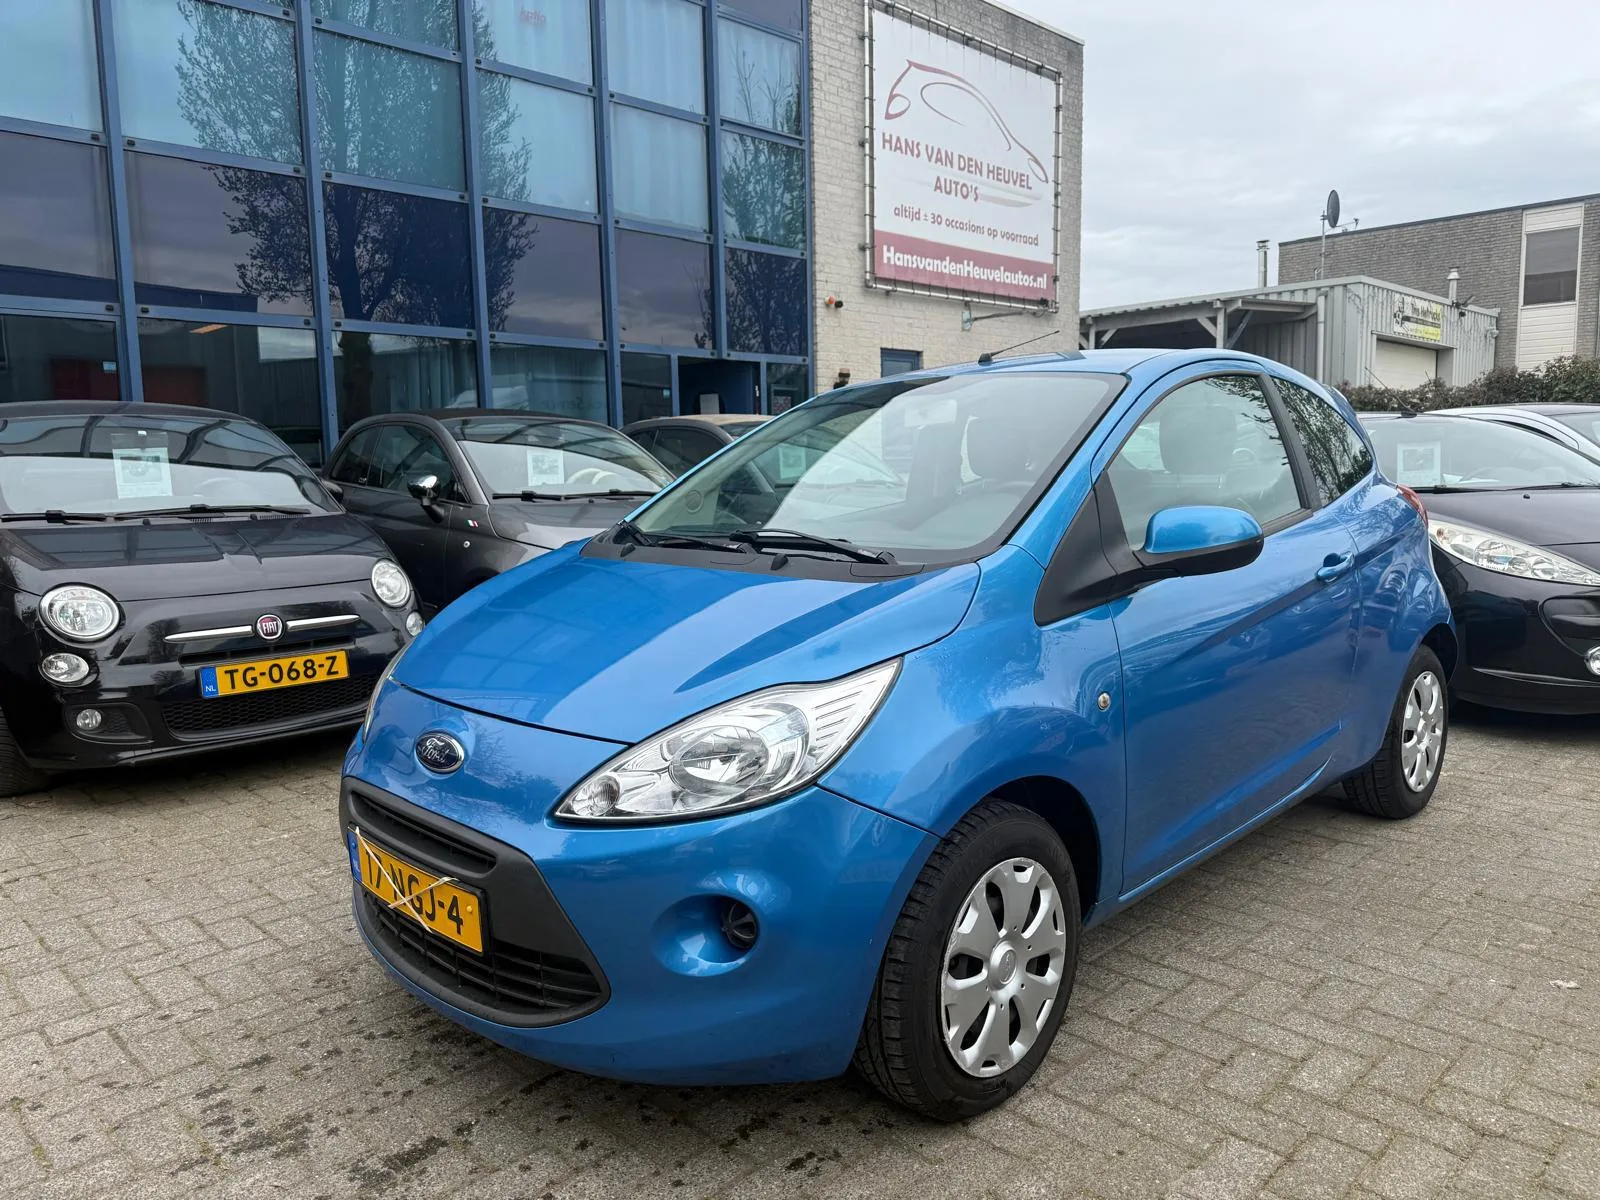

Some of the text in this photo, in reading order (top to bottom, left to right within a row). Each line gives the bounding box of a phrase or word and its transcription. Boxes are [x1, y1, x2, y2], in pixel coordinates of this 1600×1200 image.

[882, 132, 1032, 190] HANS VAN DEN HEUVEL
[933, 176, 980, 202] AUTO'S
[893, 204, 921, 222] altijd
[930, 212, 943, 225] 30
[945, 217, 985, 235] occasions
[987, 226, 998, 240] op
[1000, 229, 1039, 246] voorraad
[882, 245, 1047, 289] HansvandenHeuvelautos.nl
[262, 621, 278, 634] FIAT
[224, 655, 339, 690] TG-068-Z
